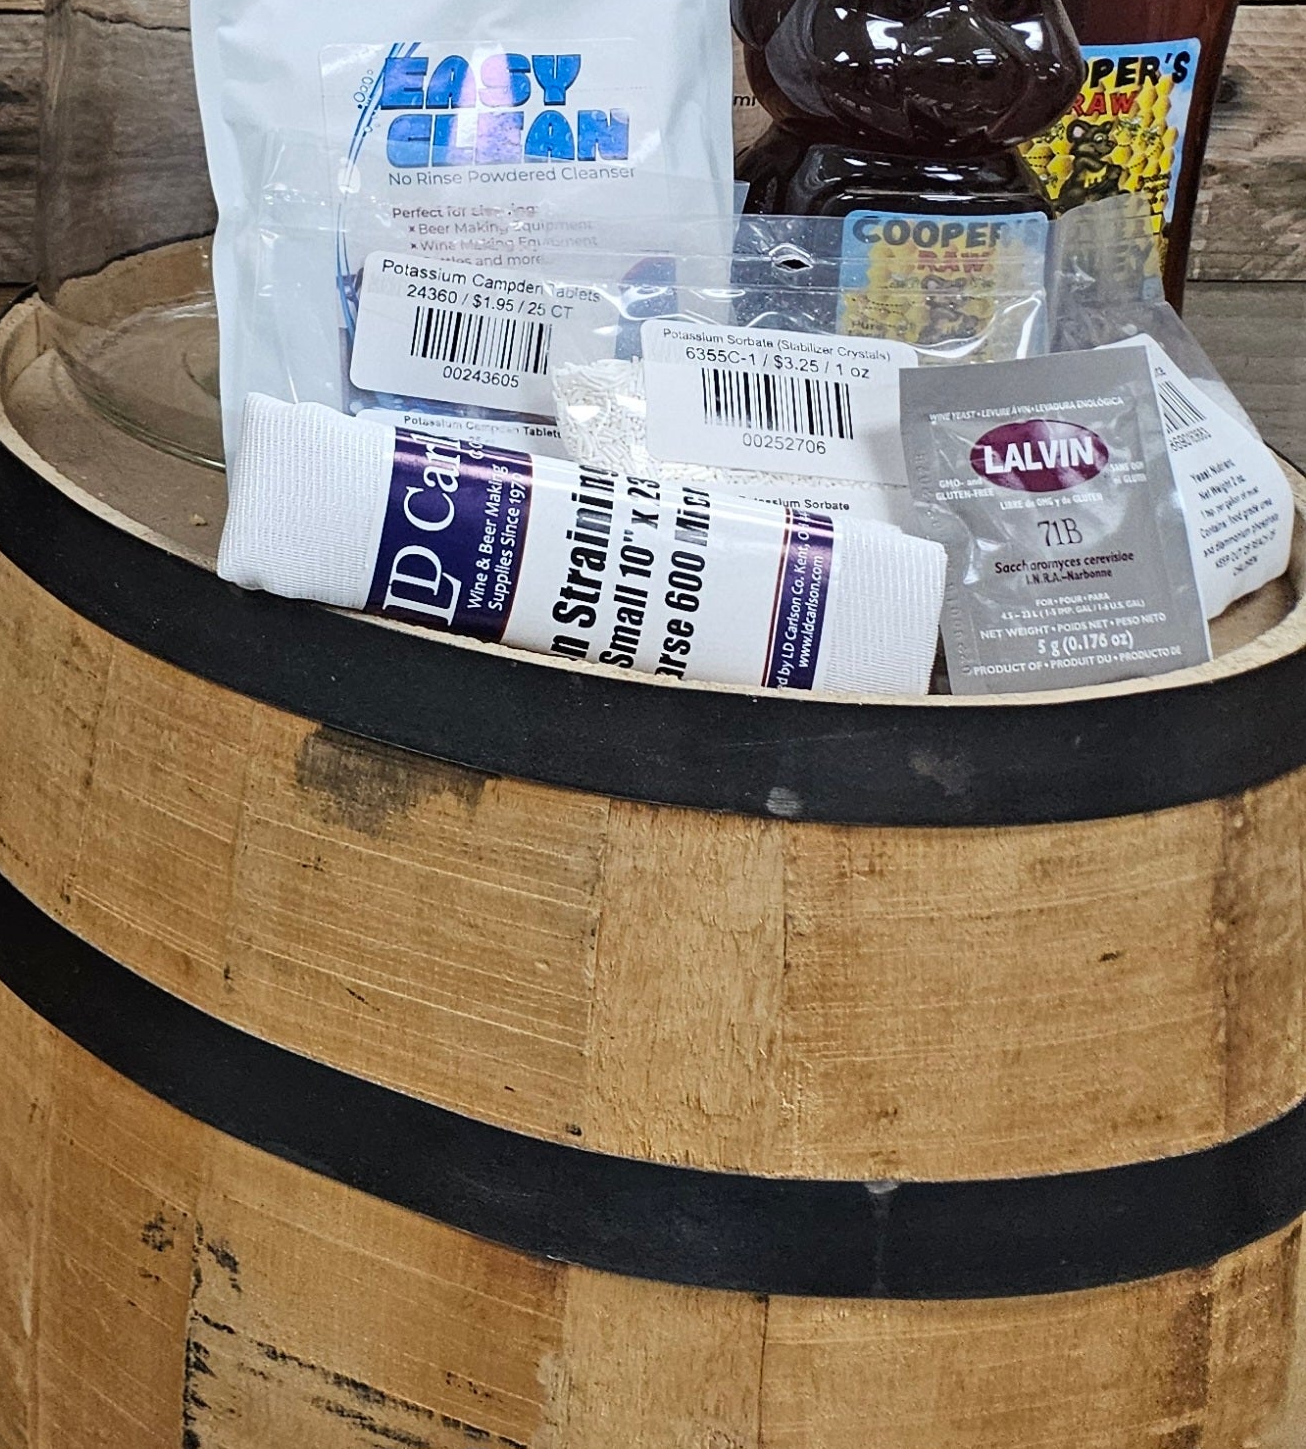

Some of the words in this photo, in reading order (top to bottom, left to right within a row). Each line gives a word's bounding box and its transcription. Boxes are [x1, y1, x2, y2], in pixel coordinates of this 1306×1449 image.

[380, 53, 582, 110] EASY
[1066, 91, 1139, 117] RAW
[386, 108, 630, 168] CLEAN
[388, 172, 412, 186] No
[417, 170, 463, 186] Rinse
[468, 167, 557, 184] Powdered
[561, 165, 637, 181] Cleanser
[392, 206, 443, 219] Perfect
[418, 222, 450, 235] Beer
[454, 220, 509, 236] Making
[474, 255, 503, 267] and
[381, 259, 467, 285] Potassium
[472, 273, 544, 297] Campden
[406, 284, 458, 304] 24360
[461, 292, 469, 306] /
[472, 292, 515, 313] $1.95
[517, 299, 525, 314] /
[527, 301, 546, 317] 25
[550, 304, 574, 320] CT
[662, 328, 725, 344] Potassium
[727, 334, 775, 348] Sorbate
[837, 346, 891, 363] Crystals)
[442, 365, 520, 389] 00243605
[685, 346, 757, 367] 6355C-1
[762, 353, 769, 368] /
[773, 353, 820, 373] $3.25
[835, 362, 844, 377] 1
[850, 367, 871, 379] oz
[951, 410, 976, 421] YEAST
[742, 431, 826, 455] 00252706
[983, 436, 1096, 475] LALVIN
[486, 464, 510, 518] Making
[935, 487, 995, 501] GLUTEN-FREE
[939, 479, 965, 490] GMO-
[630, 508, 660, 530] x
[804, 498, 850, 511] Sorbate
[478, 518, 497, 556] Beer
[1037, 517, 1084, 547] 71B
[479, 557, 492, 571] &
[488, 548, 511, 612] Supplies
[502, 505, 521, 547] Since
[620, 528, 656, 579] 10"
[793, 544, 811, 575] Kent,
[994, 556, 1082, 575] Saccharomyces
[1083, 550, 1135, 567] cerevisiae
[382, 544, 462, 628] LD
[467, 569, 488, 610] Wine
[664, 550, 707, 613] 600
[791, 576, 806, 598] Co.
[798, 555, 825, 669] www.ldcarlson.com
[1035, 598, 1053, 608] FOR
[1058, 594, 1084, 606] POUR
[1088, 591, 1111, 602] PARA
[599, 582, 649, 669] Small
[784, 598, 801, 640] Carlson
[980, 628, 1004, 640] NET
[1005, 625, 1051, 639] WEIGHT
[1057, 622, 1088, 634] POIDS
[1089, 619, 1110, 631] NET
[1115, 615, 1140, 628] PESO
[1141, 611, 1167, 625] NETO
[782, 640, 795, 662] LD
[1038, 638, 1047, 655] 5
[1050, 640, 1060, 658] g
[1062, 631, 1107, 657] (0.176
[1110, 629, 1134, 650] oz)
[778, 662, 795, 677] by
[973, 662, 1027, 677] PRODUCT
[1027, 660, 1043, 672] OF
[1050, 655, 1096, 670] PRODUIT
[1096, 653, 1112, 665] DU
[1119, 647, 1168, 663] PRODUCTO
[1169, 644, 1182, 656] DE
